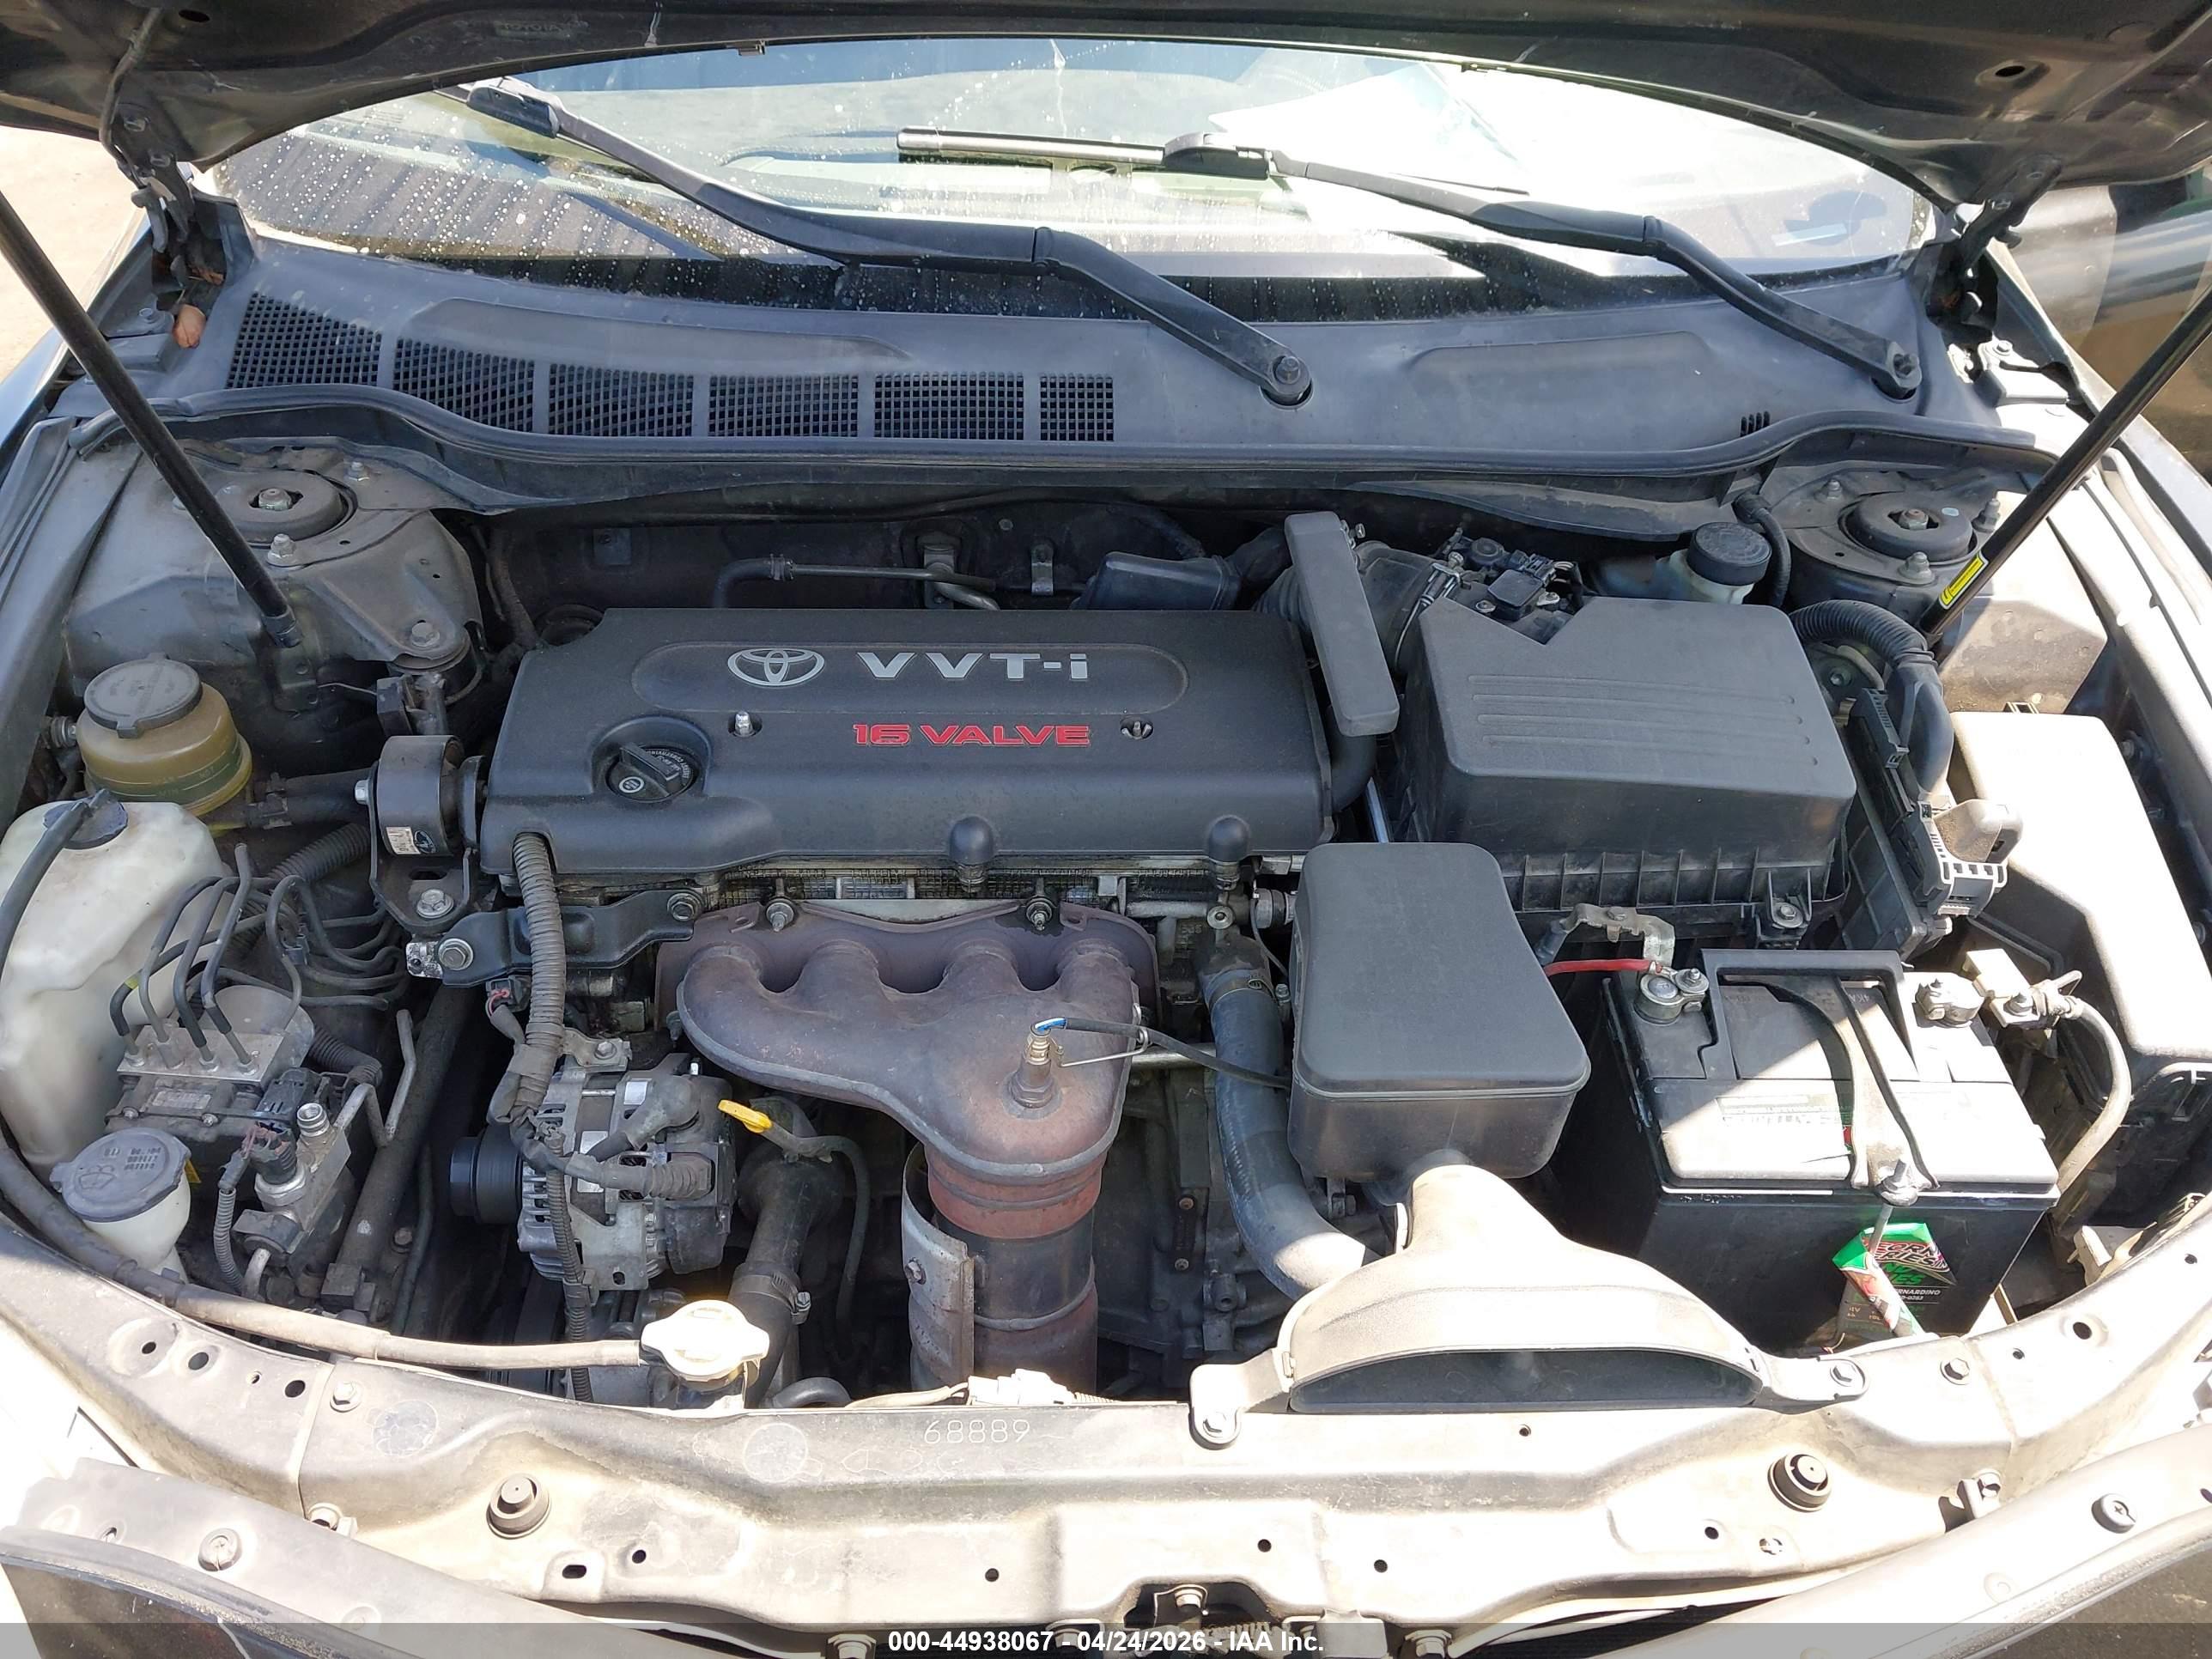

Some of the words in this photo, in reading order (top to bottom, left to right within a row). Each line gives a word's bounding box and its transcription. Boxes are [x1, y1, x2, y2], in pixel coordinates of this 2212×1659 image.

[857, 652, 1088, 679] VVT-i
[853, 724, 910, 745] 16
[920, 725, 1091, 745] VALVE
[924, 1419, 1030, 1443] 68889
